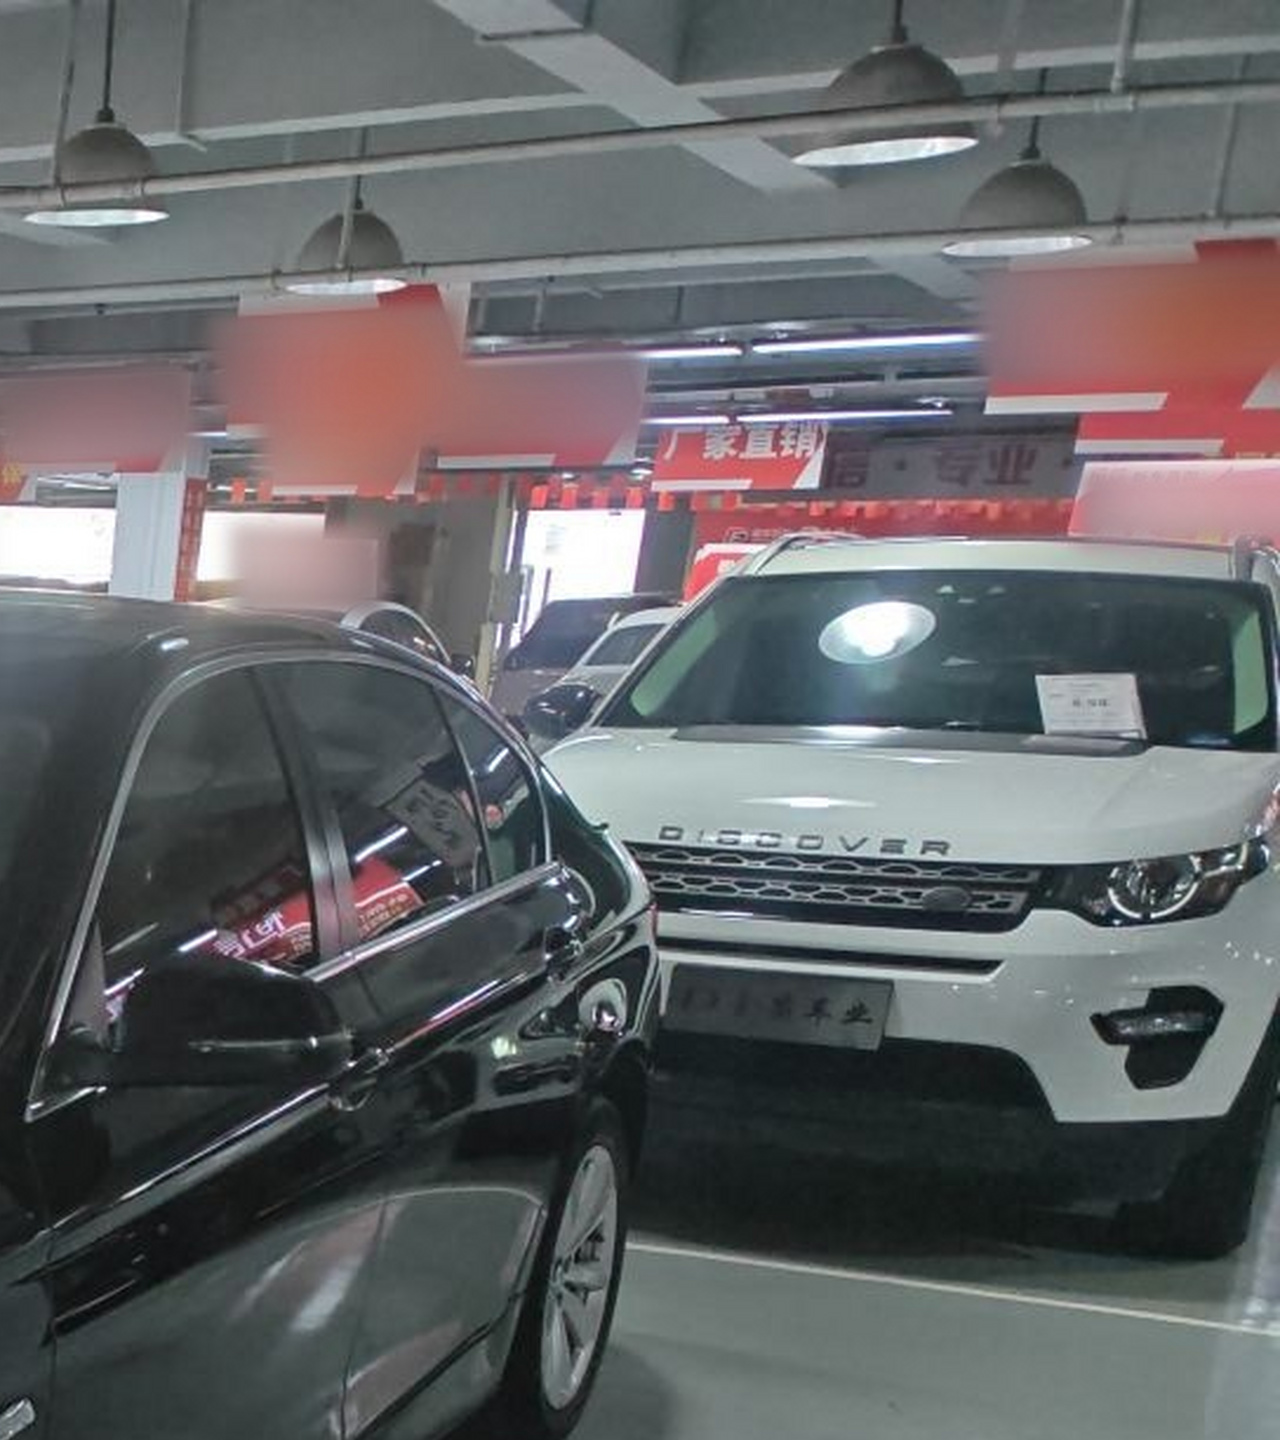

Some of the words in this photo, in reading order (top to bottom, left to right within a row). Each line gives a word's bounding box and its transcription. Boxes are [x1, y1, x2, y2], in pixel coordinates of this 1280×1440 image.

[663, 423, 827, 461] 厂家直销
[658, 825, 951, 856] DISCOVER
